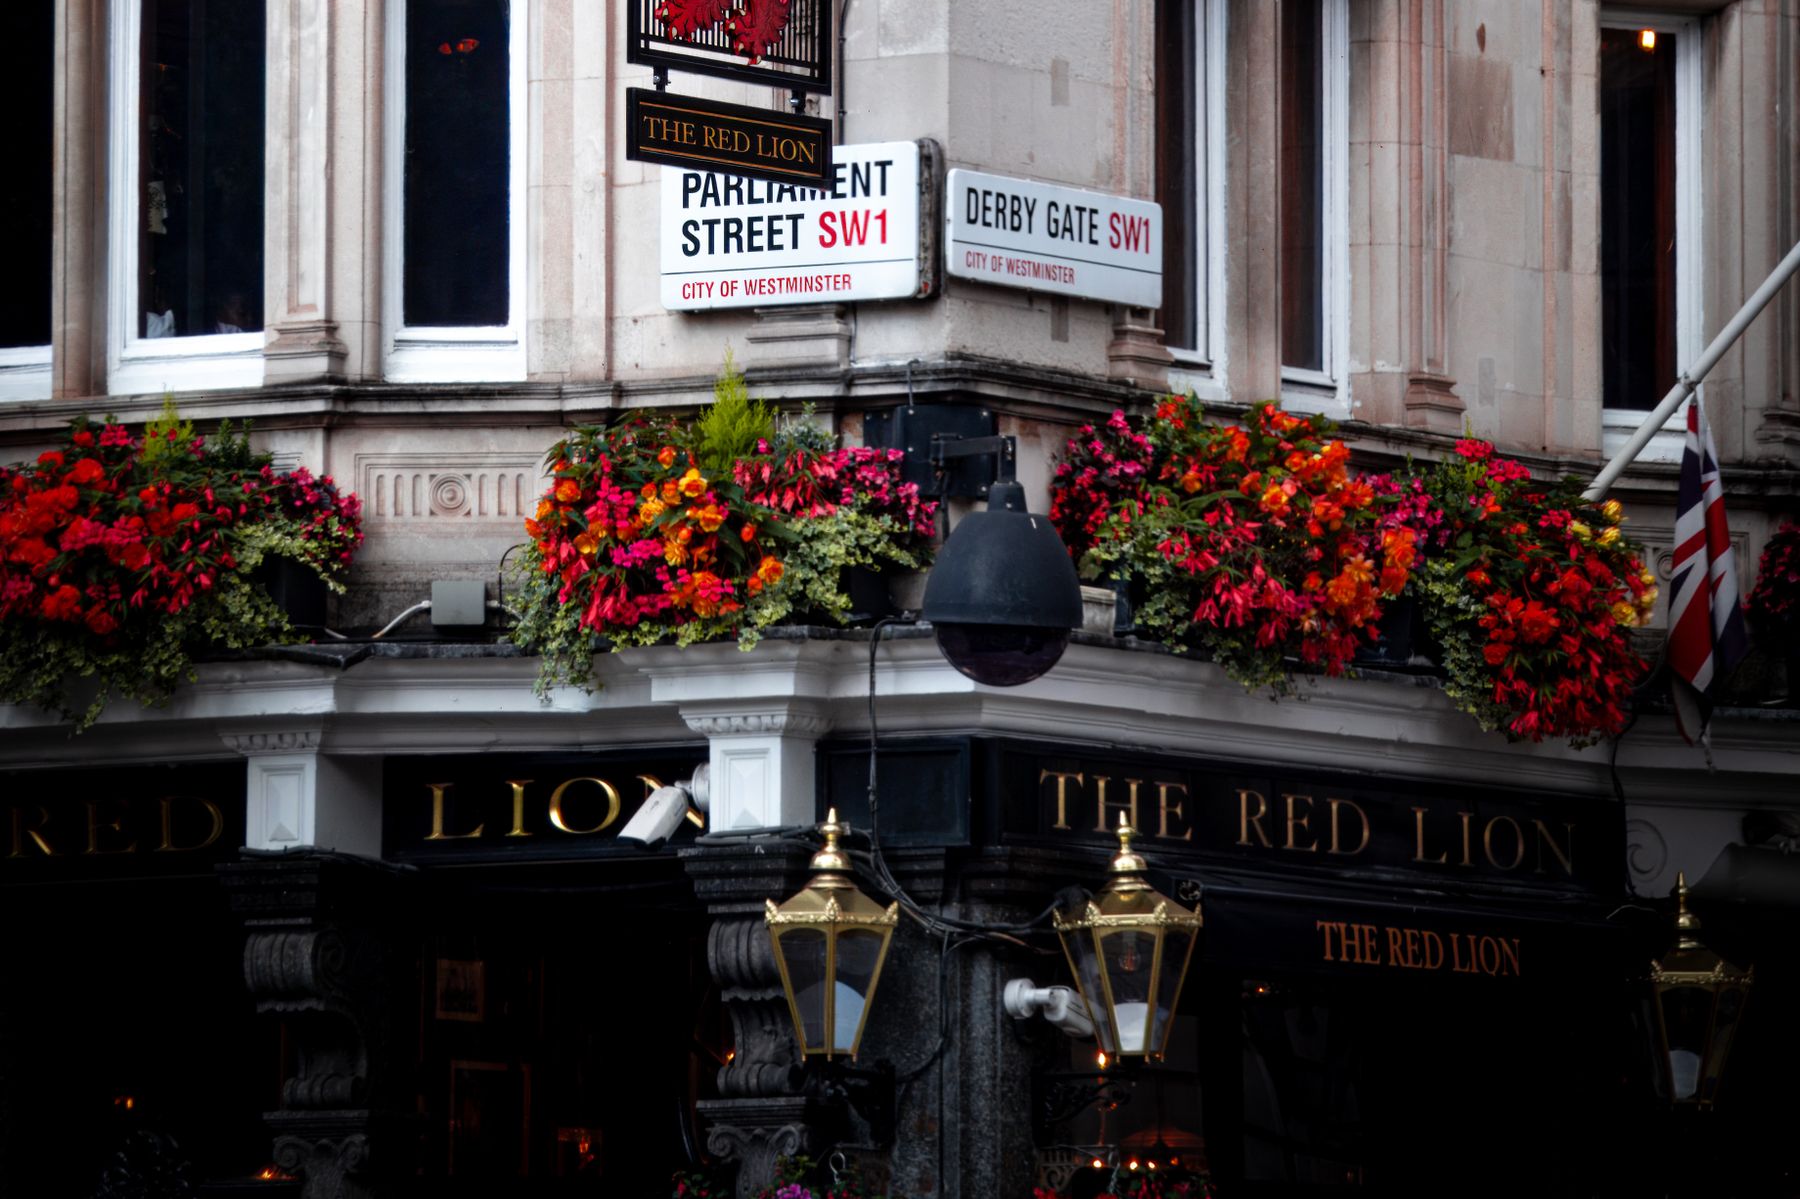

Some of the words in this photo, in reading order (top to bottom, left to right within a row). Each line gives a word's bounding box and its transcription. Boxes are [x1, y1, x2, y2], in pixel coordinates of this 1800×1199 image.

[643, 115, 697, 145] THE
[703, 125, 750, 153] RED
[757, 134, 816, 165] LION
[681, 213, 805, 257] STREET
[818, 208, 888, 249] SW1
[967, 187, 1037, 234] DERBY
[1047, 200, 1099, 245] GATE
[1109, 212, 1150, 255] SW1
[682, 282, 715, 300] CITY
[720, 280, 739, 297] OF
[744, 274, 852, 296] WESTMINSTER
[965, 250, 988, 271] CITY
[991, 256, 1004, 273] OF
[1006, 258, 1075, 285] WESTMINSTER
[8, 795, 224, 858] RED
[1040, 769, 1193, 841] THE
[1236, 788, 1371, 855] RED
[1413, 807, 1575, 876] LION
[1316, 920, 1381, 963] THE
[1388, 927, 1444, 970] RED
[1452, 933, 1521, 977] LION
